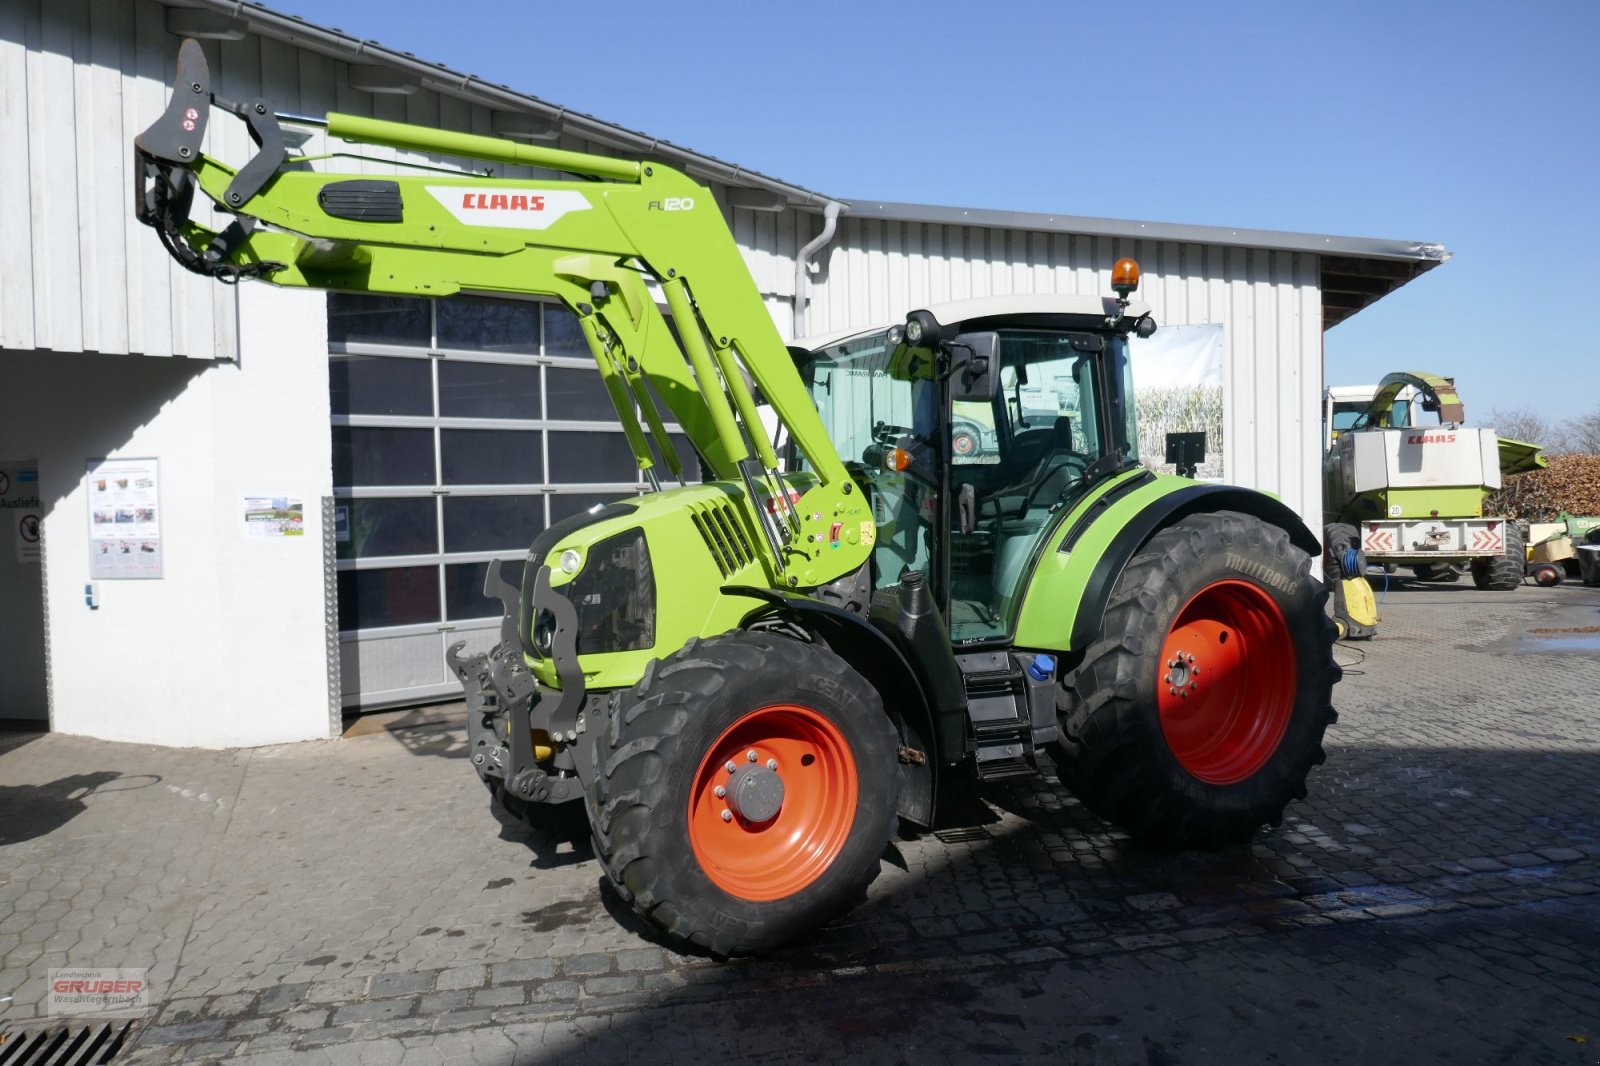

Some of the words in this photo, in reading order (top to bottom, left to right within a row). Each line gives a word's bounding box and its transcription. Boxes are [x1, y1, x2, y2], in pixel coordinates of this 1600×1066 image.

[462, 193, 545, 211] CLAAS
[648, 197, 695, 212] FL120
[1407, 434, 1456, 444] CLAAS
